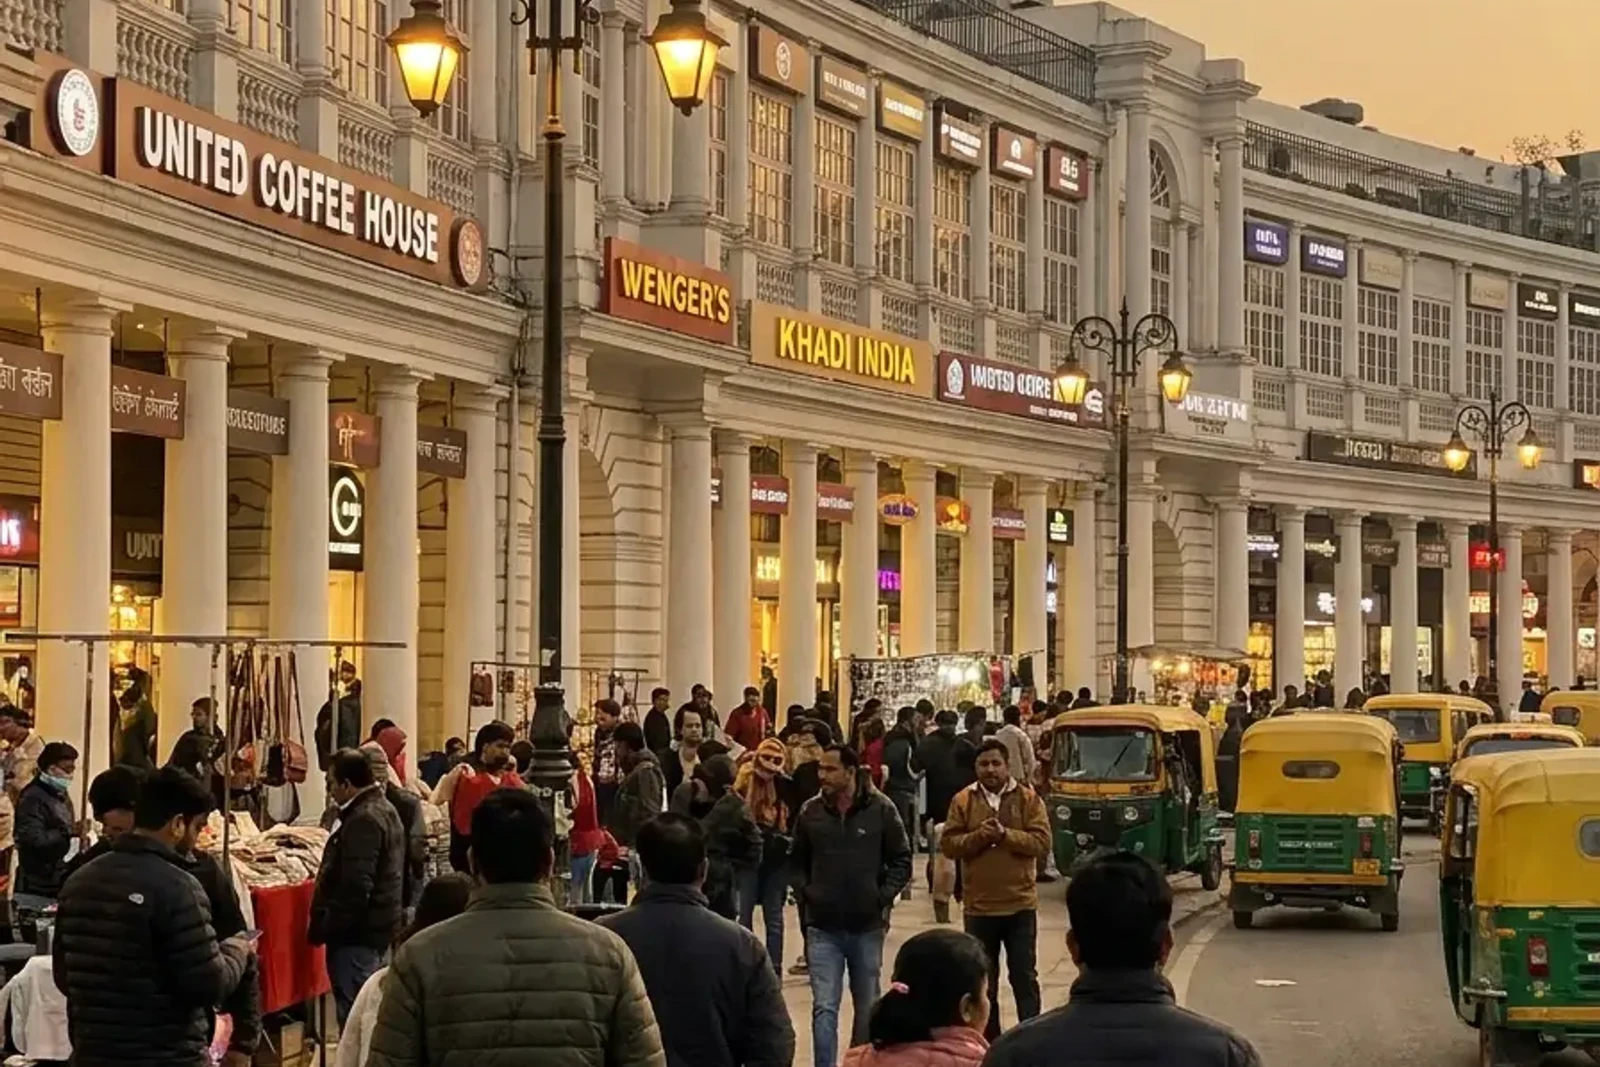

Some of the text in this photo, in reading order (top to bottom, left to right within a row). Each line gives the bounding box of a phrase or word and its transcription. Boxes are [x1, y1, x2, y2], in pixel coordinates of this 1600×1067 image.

[143, 107, 248, 196] UNITED
[260, 153, 355, 235] COFFEE
[364, 190, 439, 263] HOUSE
[621, 258, 730, 324] WENGER'S
[779, 318, 852, 369] KHADI
[857, 337, 916, 386] INDIA
